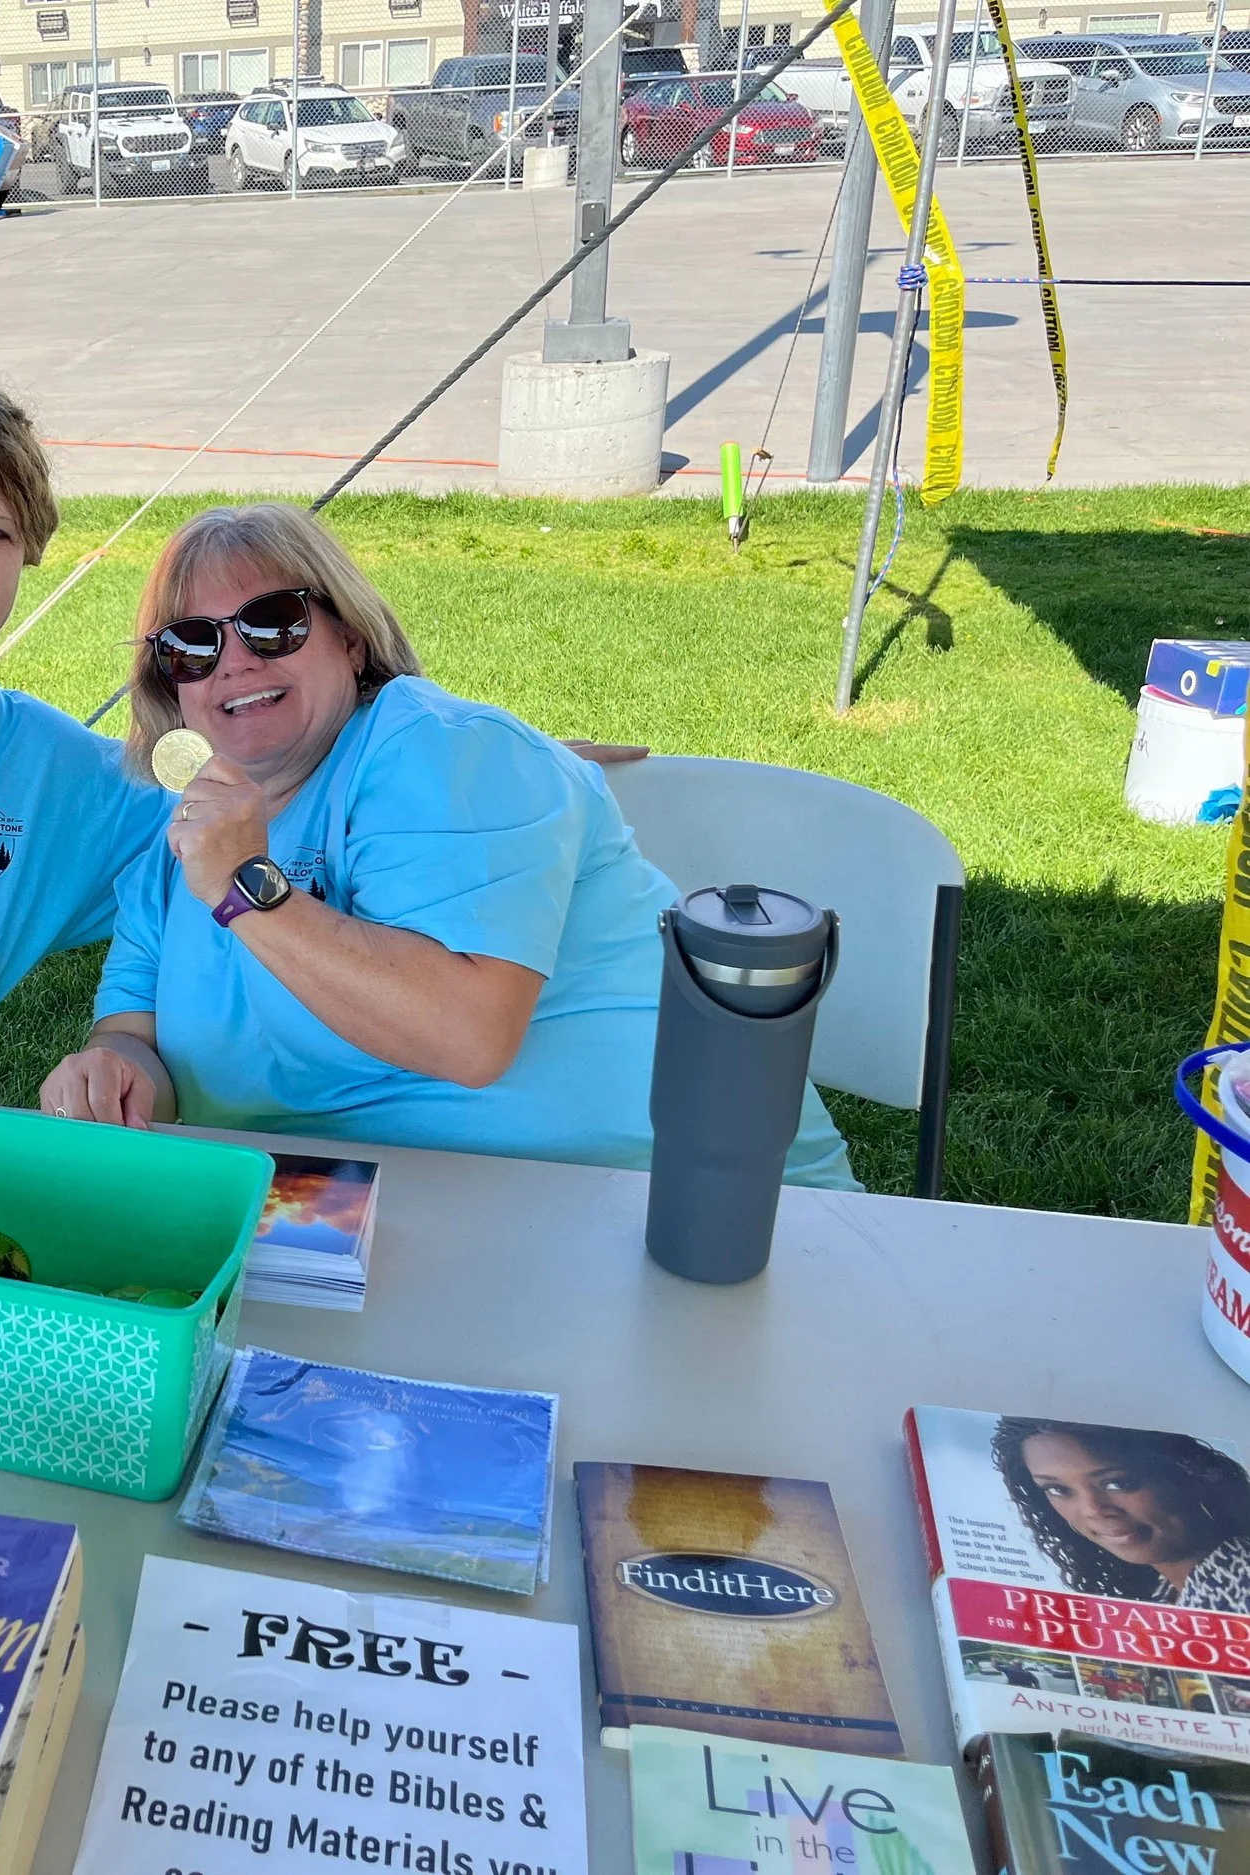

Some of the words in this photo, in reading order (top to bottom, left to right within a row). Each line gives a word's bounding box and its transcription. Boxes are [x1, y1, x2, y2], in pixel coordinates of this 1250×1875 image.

[541, 0, 585, 16] Bffalo
[948, 1515, 964, 1525] The
[966, 1518, 1006, 1532] Inspiring
[950, 1526, 970, 1537] True
[972, 1530, 995, 1541] Story
[952, 1538, 971, 1548] How
[974, 1541, 992, 1550] One
[993, 1544, 1027, 1556] Woman
[954, 1550, 982, 1561] Saved
[997, 1555, 1030, 1568] Atlanta
[617, 1561, 836, 1606] FinditHere
[957, 1561, 988, 1573] School
[989, 1565, 1017, 1577] Under
[1020, 1570, 1046, 1582] Siege
[987, 1615, 1014, 1631] FOR
[1022, 1621, 1032, 1632] A
[1002, 1588, 1250, 1643] PREPARED
[237, 1608, 470, 1687] FREE
[162, 1680, 280, 1724] Please
[294, 1700, 371, 1746] help
[385, 1723, 540, 1768] yourself
[656, 1698, 699, 1713] New
[715, 1706, 847, 1728] Testament
[1011, 1692, 1211, 1735] ANTOINETTE
[1077, 1722, 1112, 1737] with
[1116, 1725, 1155, 1743] Alex
[143, 1730, 176, 1765] to
[189, 1744, 256, 1786] any
[268, 1753, 305, 1787] of
[316, 1758, 374, 1798] the
[389, 1770, 505, 1823] Bibles
[519, 1793, 548, 1830] &
[703, 1744, 899, 1835] Live
[1034, 1750, 1226, 1833] Each
[121, 1786, 273, 1855] Reading
[287, 1814, 474, 1875] Materials
[754, 1826, 784, 1856] in
[795, 1834, 856, 1864] the
[1046, 1806, 1218, 1875] New
